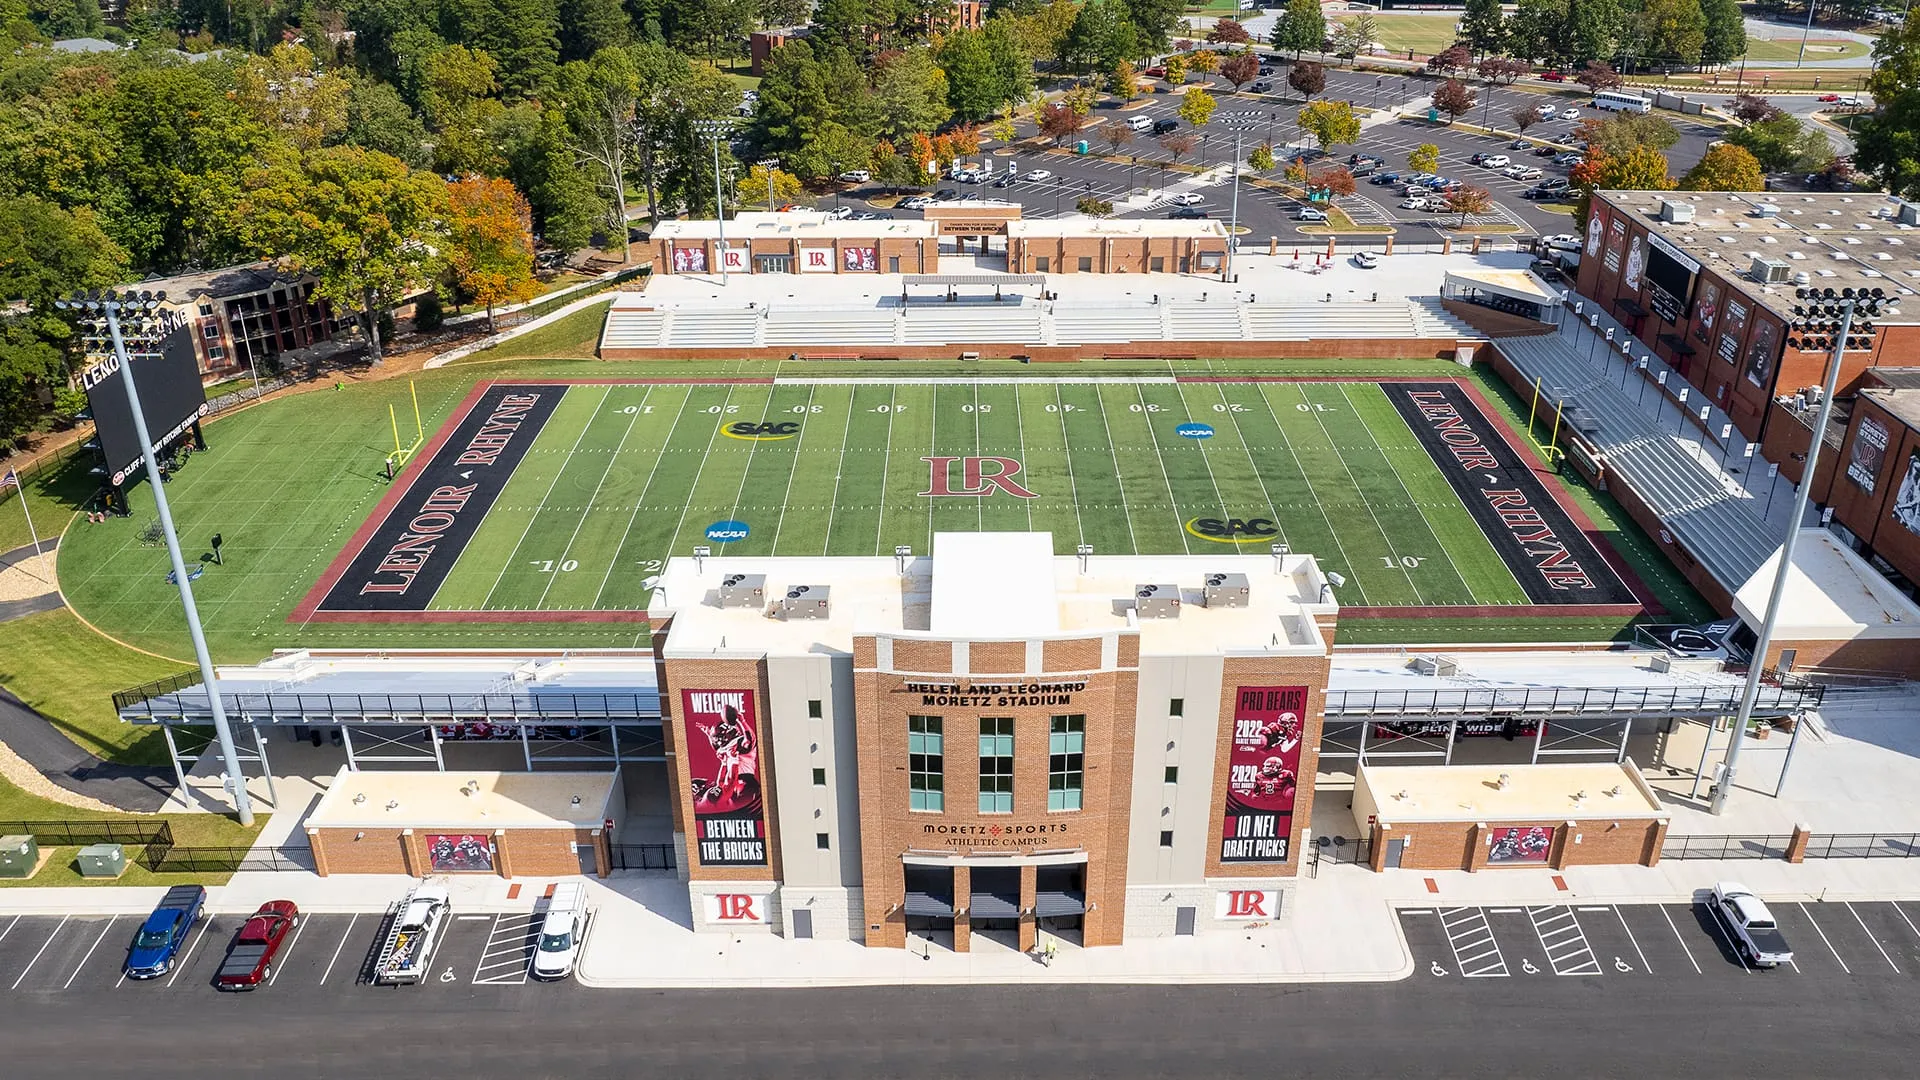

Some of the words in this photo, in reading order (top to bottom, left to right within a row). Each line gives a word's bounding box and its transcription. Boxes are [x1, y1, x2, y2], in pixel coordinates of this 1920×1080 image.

[808, 252, 827, 266] LR
[82, 350, 133, 390] LENO
[731, 422, 799, 435] SAC
[124, 458, 140, 476] CLIFF
[181, 411, 199, 430] FAMILY
[917, 456, 1041, 498] LR
[1847, 464, 1875, 492] BEARS
[359, 483, 479, 595] LENOIR
[454, 393, 541, 466] RHYNE
[1407, 390, 1499, 471] LENOIR
[1480, 487, 1596, 590] RHYNE
[707, 530, 747, 539] NCAA
[1197, 518, 1277, 535] SAC
[908, 683, 961, 694] HELEN
[967, 684, 1001, 695] AND
[1008, 683, 1086, 695] LEONARD
[690, 692, 746, 714] WELCOME
[922, 695, 991, 706] MORETZ
[997, 695, 1070, 706] STADIUM
[1241, 691, 1264, 711] PRO
[1266, 690, 1301, 711] BEARS
[1235, 720, 1263, 738] 2022
[1466, 724, 1504, 732] WIDE
[1231, 765, 1258, 783] 2020
[706, 820, 755, 838] BETWEEN
[923, 824, 986, 834] MORETZ
[1005, 823, 1067, 834] SPORTS
[1237, 815, 1251, 837] 10
[1253, 815, 1275, 837] NFL
[944, 838, 999, 846] ATHLETIC
[1002, 837, 1048, 846] CAMPUS
[1223, 840, 1254, 857] DRAFT
[1255, 840, 1286, 857] PICKS
[701, 842, 722, 860] THE
[723, 842, 763, 860] BRICKS
[715, 894, 760, 920] LR
[1226, 890, 1268, 916] LR
